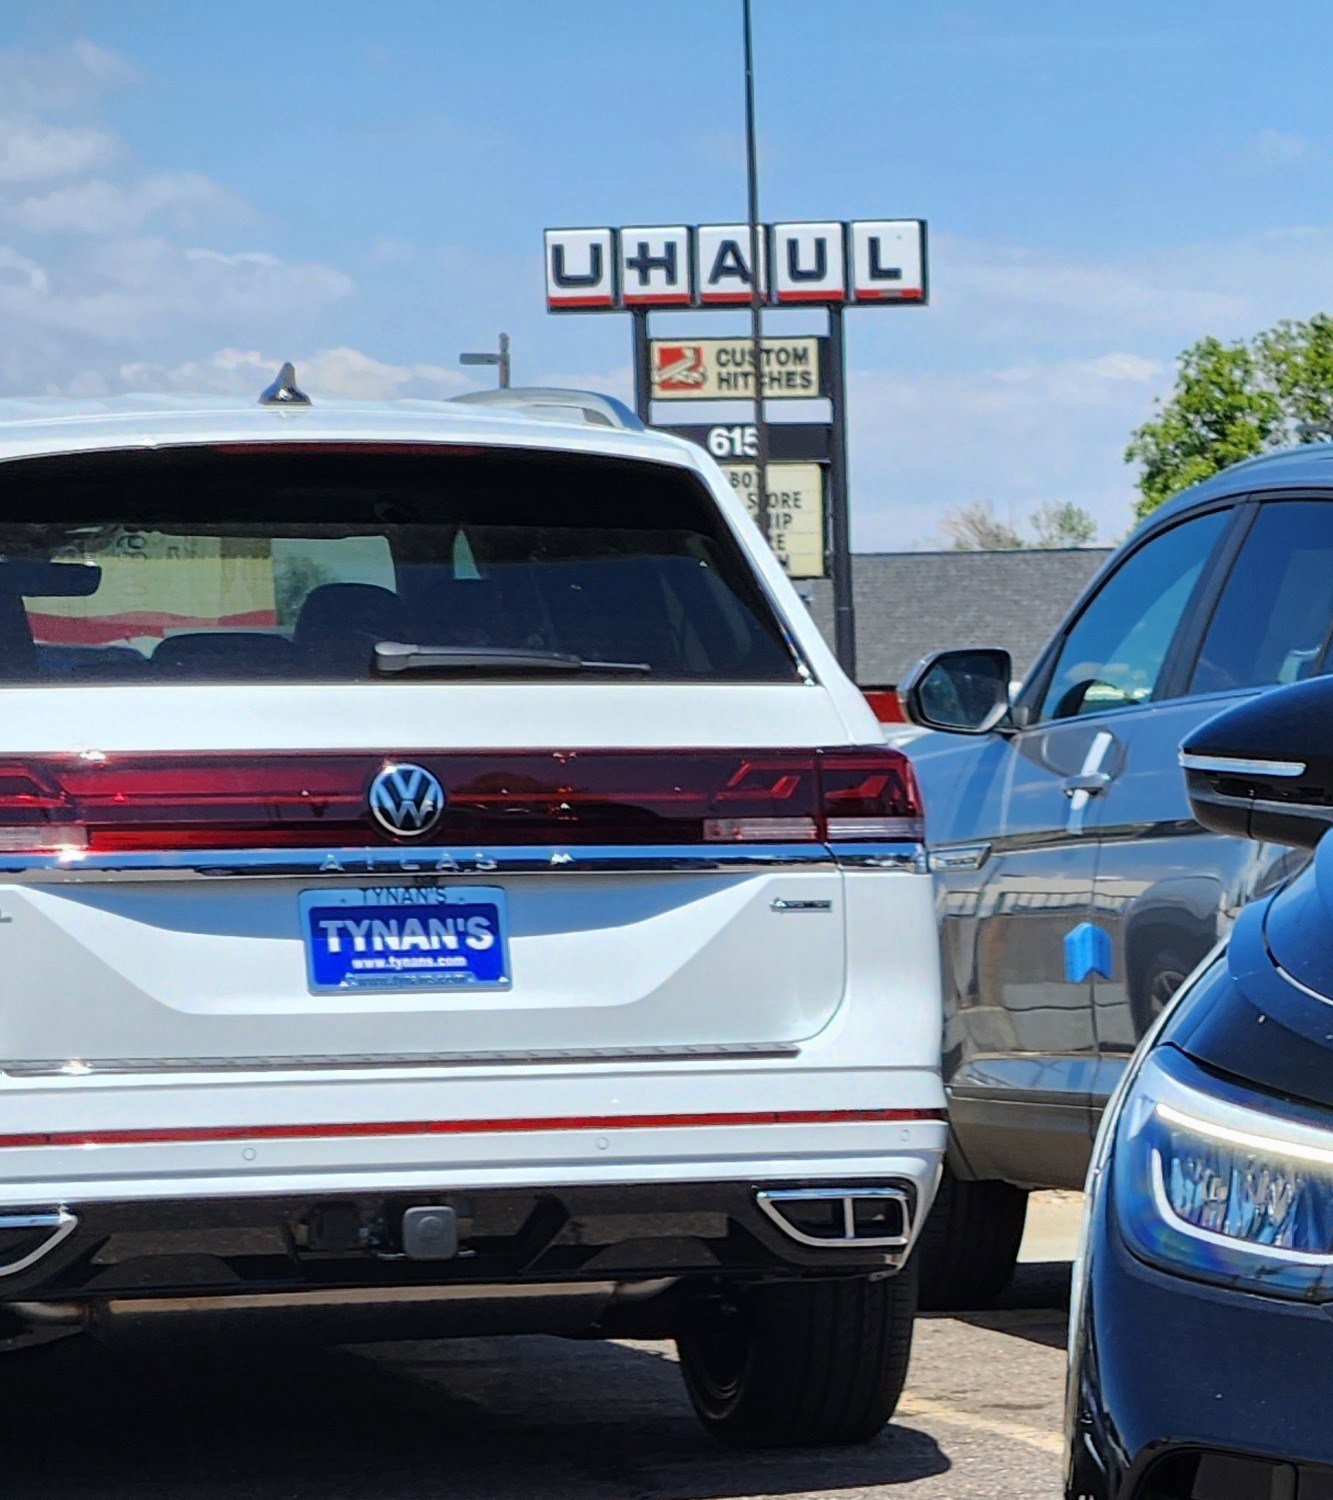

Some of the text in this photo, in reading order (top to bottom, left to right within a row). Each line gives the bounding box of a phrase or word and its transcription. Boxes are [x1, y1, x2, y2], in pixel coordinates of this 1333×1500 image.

[717, 370, 812, 390] HITHES
[747, 491, 802, 509] SORE
[319, 916, 495, 954] TYNAN'S
[352, 956, 467, 970] www.tynans.com
